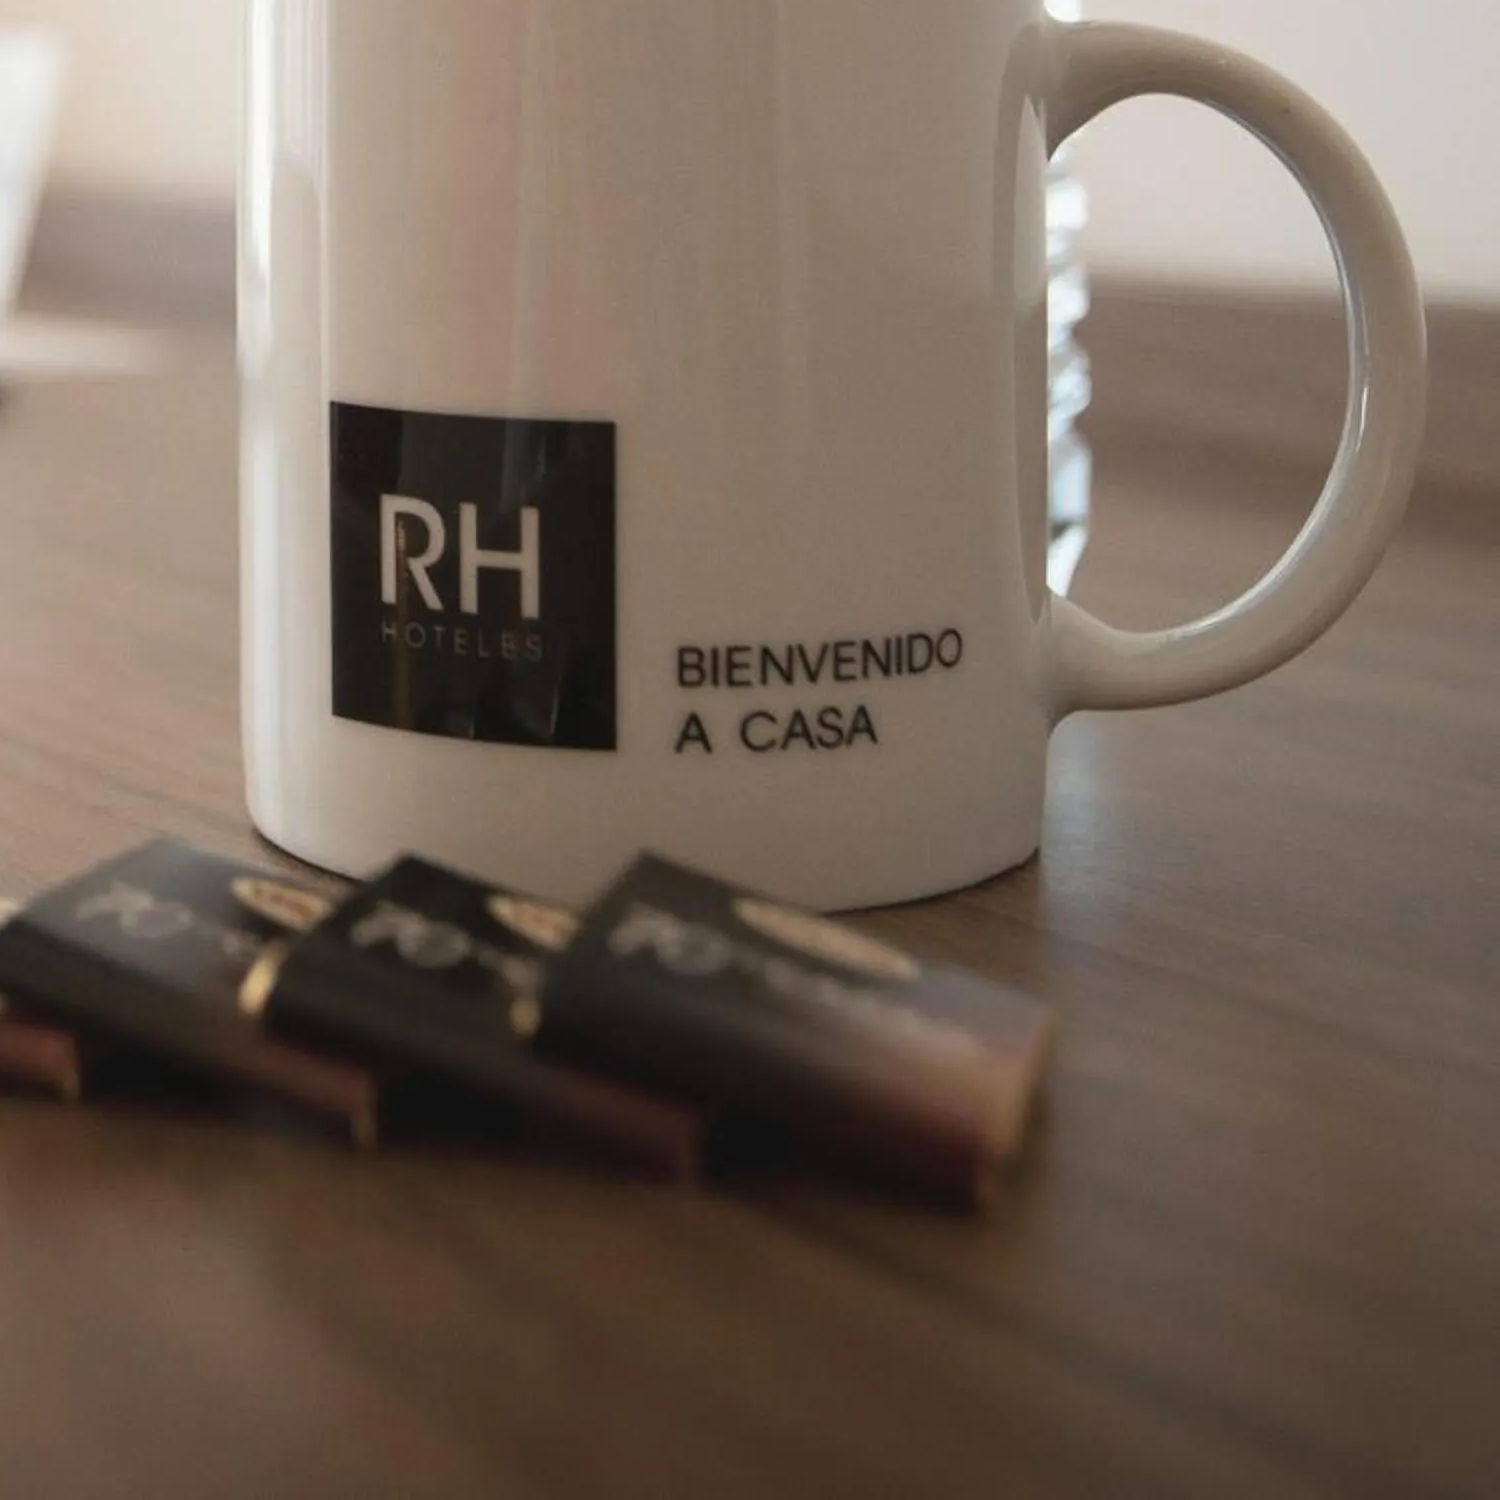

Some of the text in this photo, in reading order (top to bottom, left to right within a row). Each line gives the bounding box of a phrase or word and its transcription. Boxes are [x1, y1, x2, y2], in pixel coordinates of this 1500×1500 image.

[380, 493, 539, 619] RH
[381, 617, 542, 661] HOTELES
[677, 628, 963, 688] BIENVENIDO
[674, 704, 879, 754] A CASA
